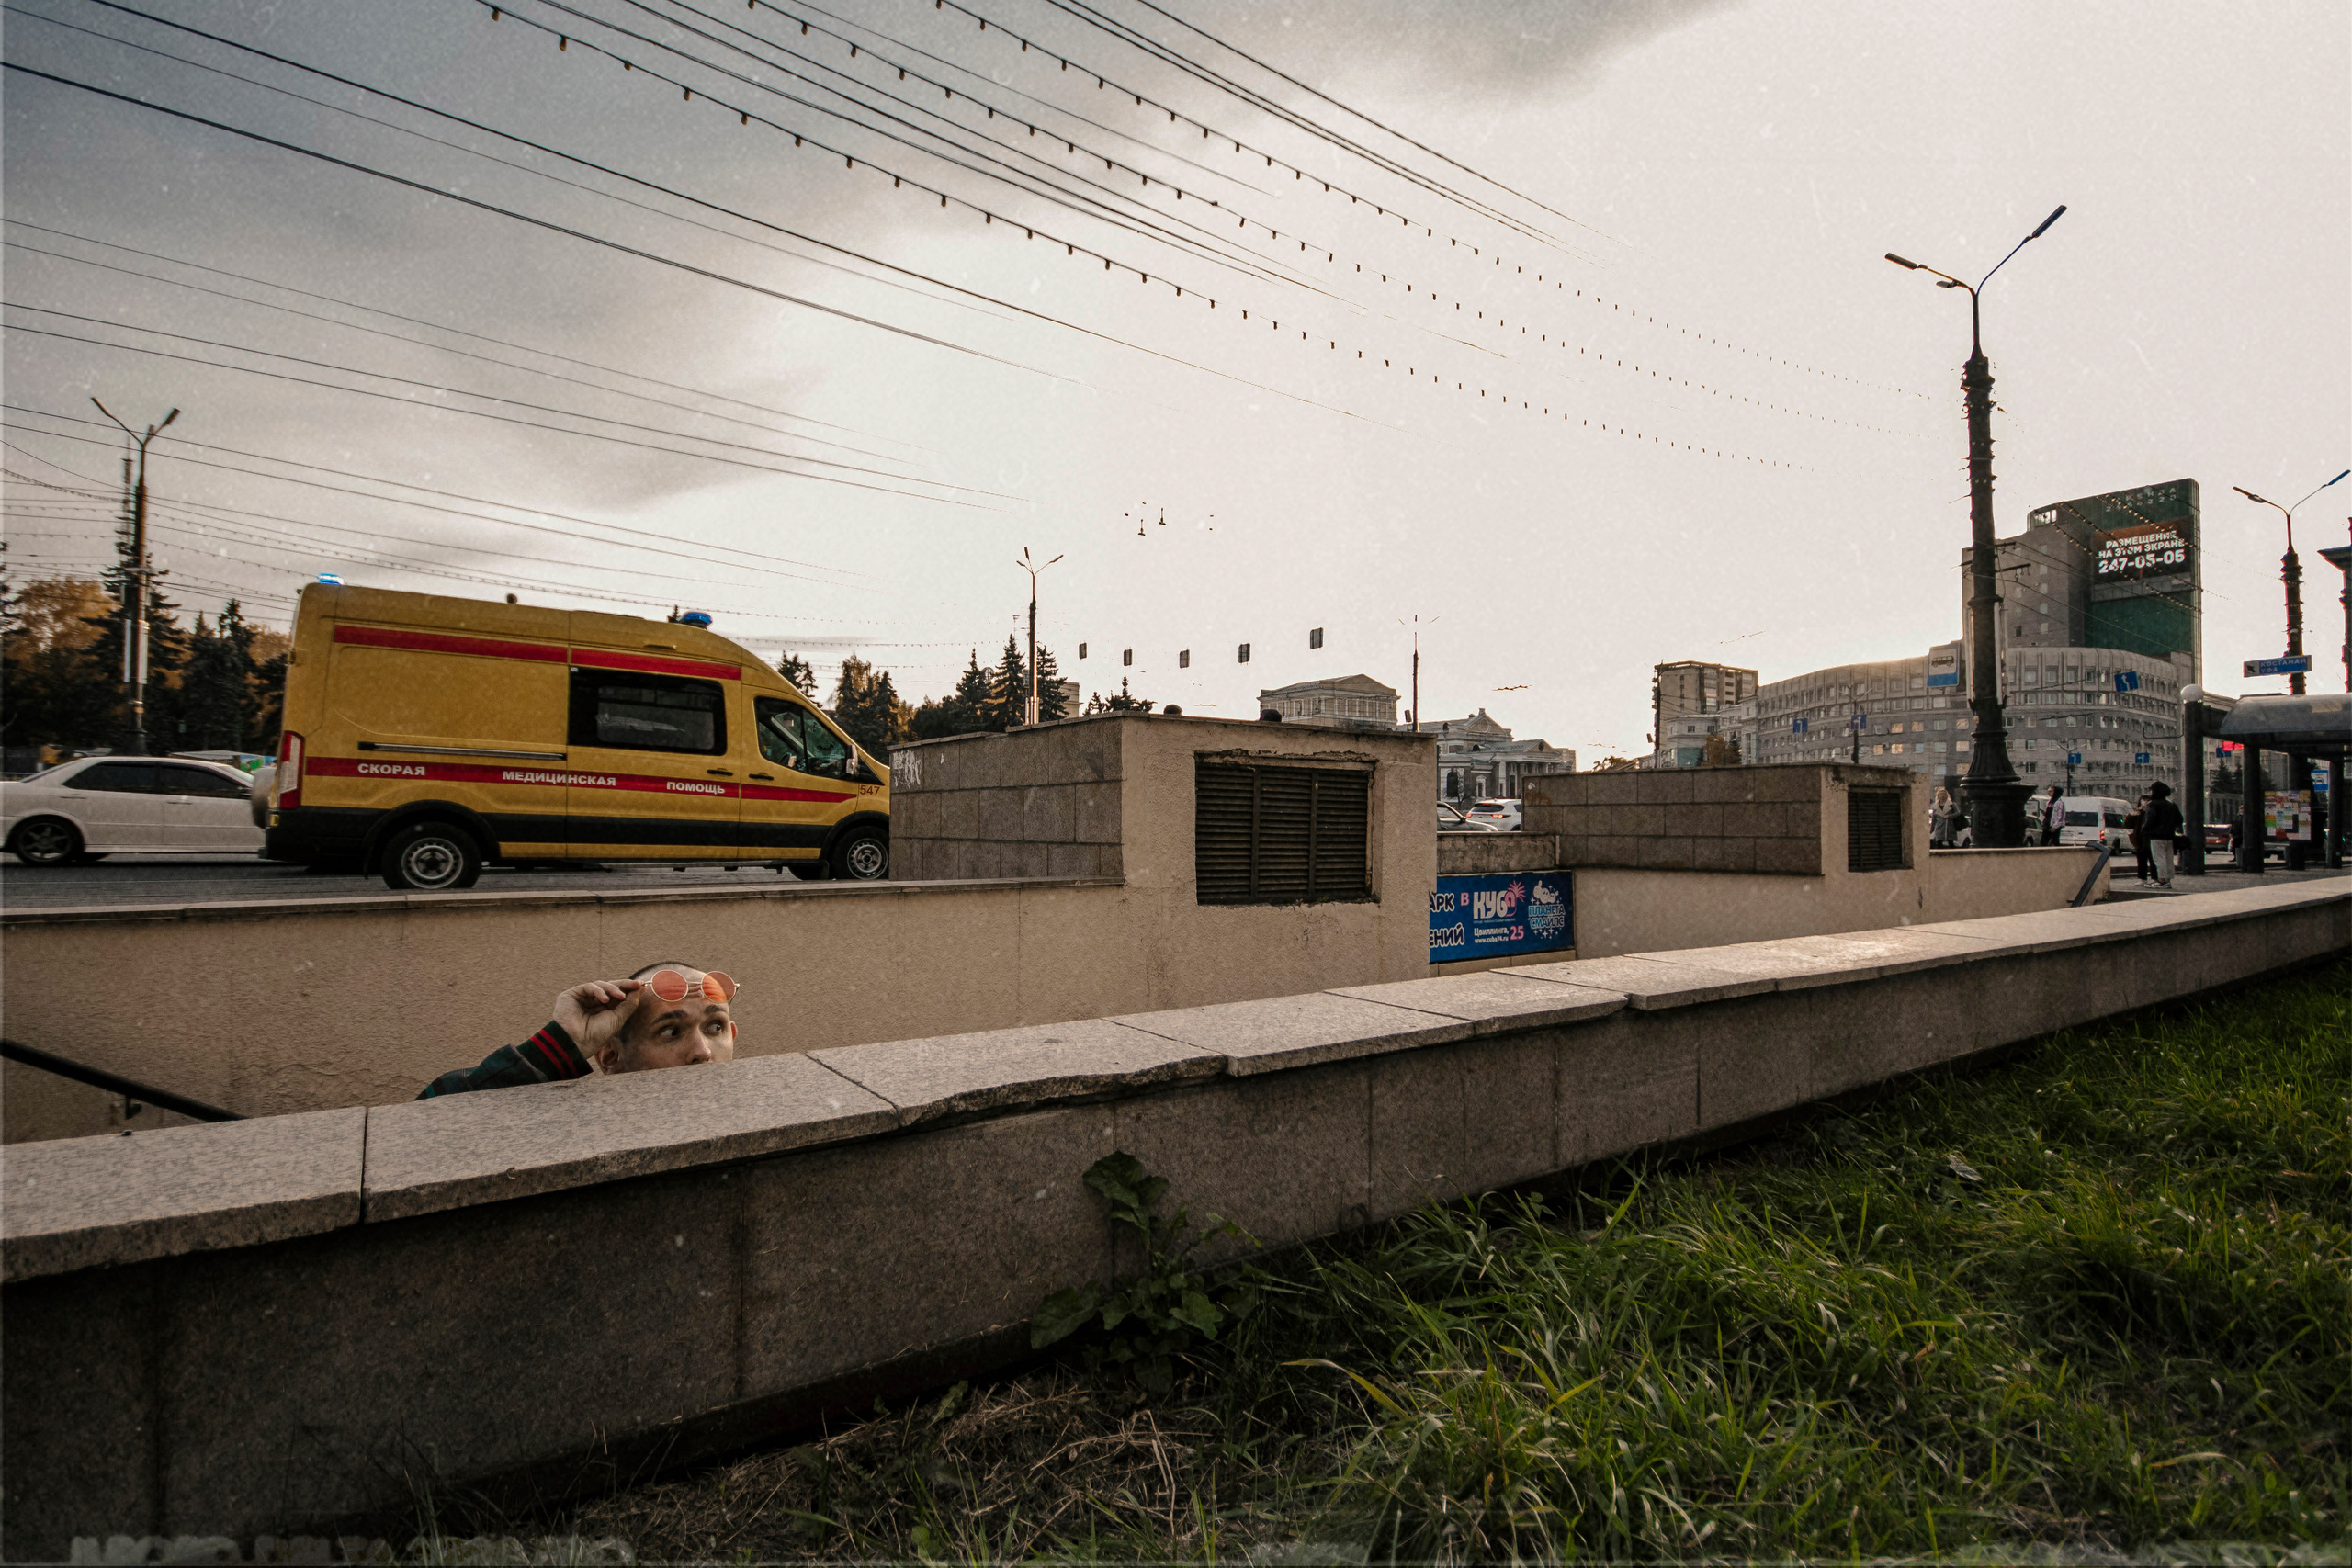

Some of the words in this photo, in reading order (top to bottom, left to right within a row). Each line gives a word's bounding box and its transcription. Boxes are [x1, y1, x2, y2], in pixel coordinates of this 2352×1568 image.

[2106, 530, 2178, 549] РАЗМЕЩЕНИЕ
[2098, 549, 2113, 559] НА
[2114, 545, 2143, 557] ЭТОМ
[2144, 538, 2186, 552] ЭКРАНЕ
[2098, 548, 2186, 574] 247-05-05
[356, 761, 426, 777] СКОРАЯ
[502, 770, 617, 788] МЕДИЦИНСКАЯ
[666, 780, 726, 796] ПОМОЩЬ
[860, 784, 880, 795] 547
[1528, 904, 1566, 918] ПЛАНЕТА
[1530, 915, 1566, 929] СМАЙЛС
[1510, 925, 1525, 941] 25
